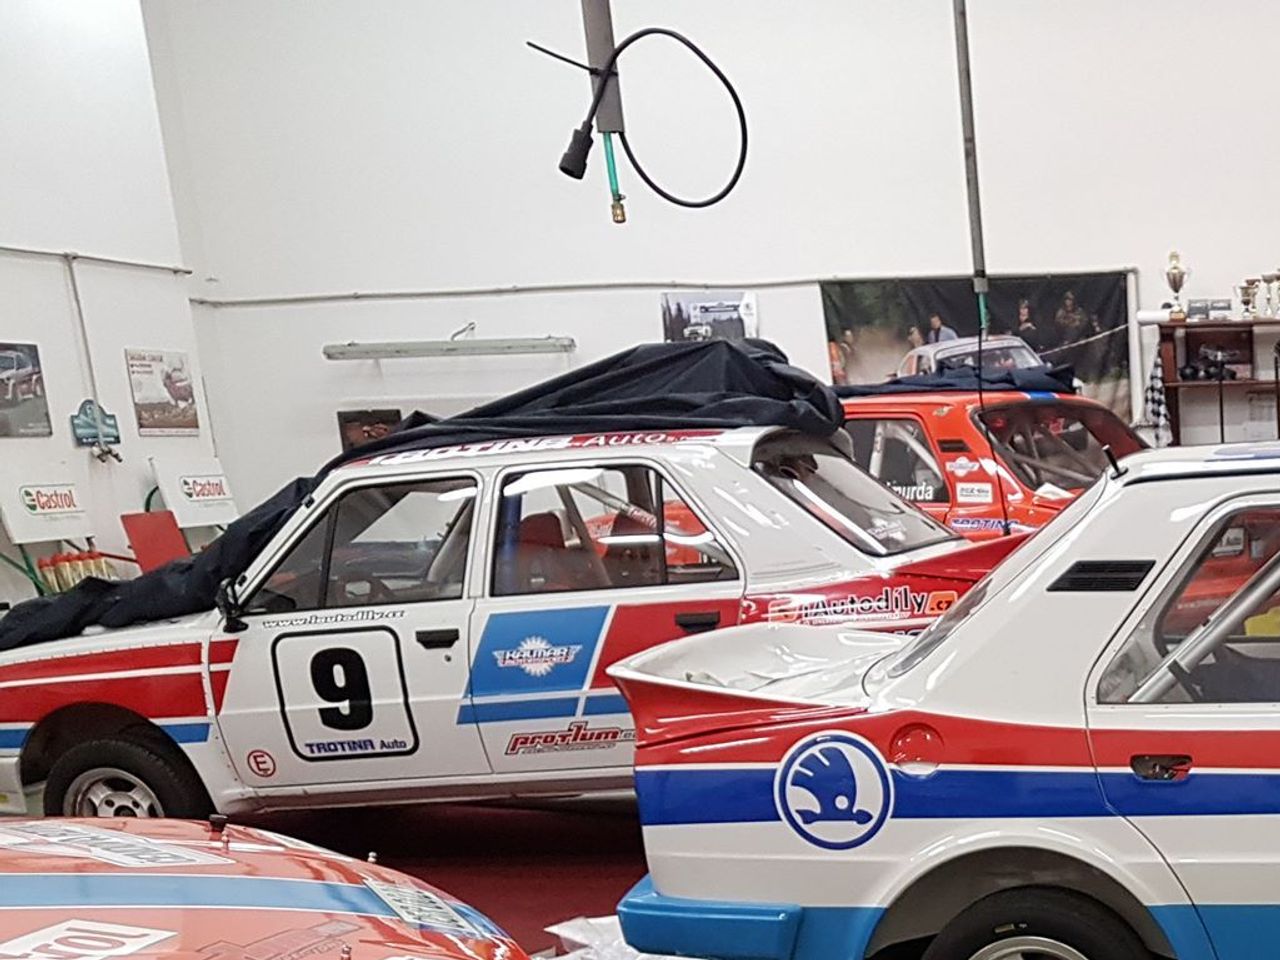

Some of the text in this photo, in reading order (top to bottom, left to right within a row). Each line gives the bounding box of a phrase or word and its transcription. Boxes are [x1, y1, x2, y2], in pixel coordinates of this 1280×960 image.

[192, 480, 226, 498] Castrol
[36, 489, 77, 510] Castrol
[310, 647, 374, 731] 9
[305, 739, 408, 754] TROTINA Auto
